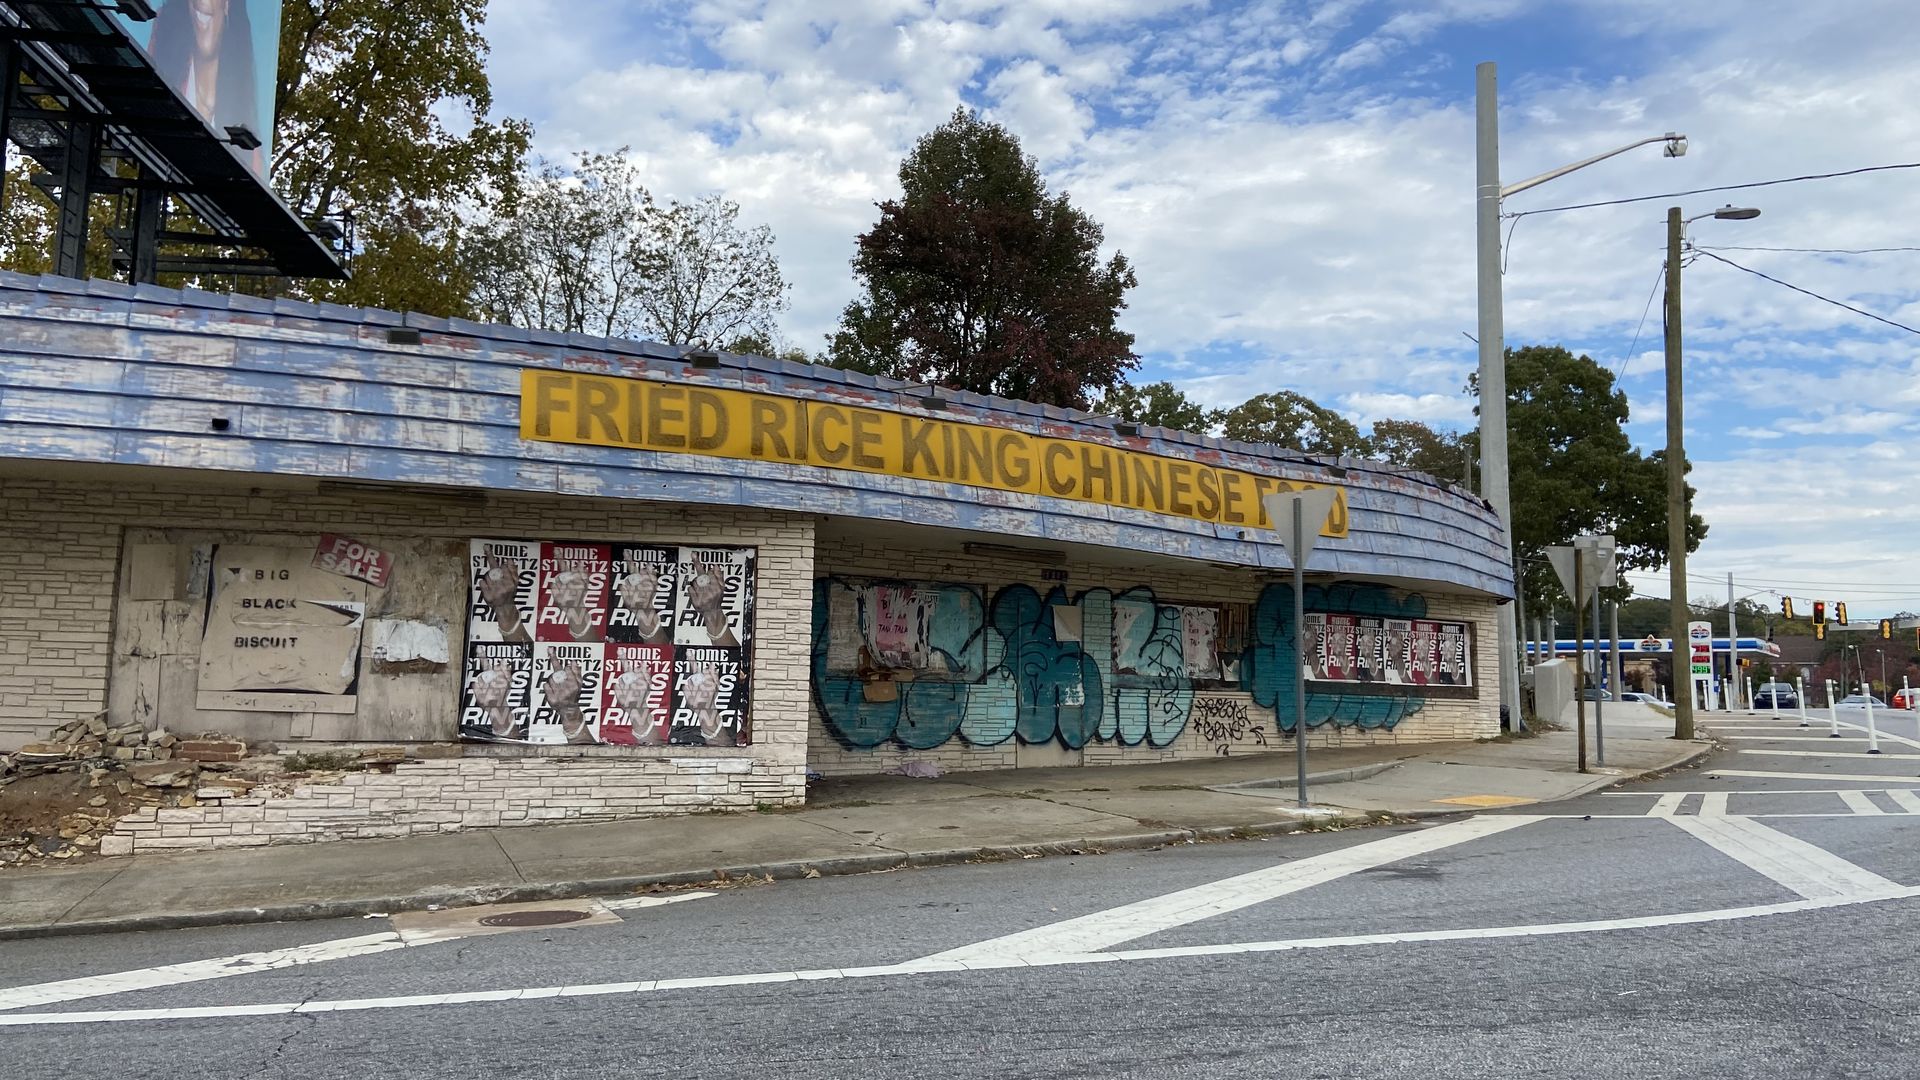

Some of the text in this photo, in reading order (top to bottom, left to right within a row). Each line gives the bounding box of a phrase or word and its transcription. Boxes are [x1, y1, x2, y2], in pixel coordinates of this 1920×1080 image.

[535, 374, 1346, 533] FRIED RICE KING CHINESE FD
[331, 539, 380, 566] FOR
[320, 553, 382, 583] SALE
[255, 569, 289, 580] BIG
[474, 568, 536, 588] KS
[681, 575, 742, 593] KS
[475, 587, 531, 606] TE
[684, 593, 737, 610] TE
[242, 598, 297, 609] BLACK
[1305, 615, 1321, 623] OME
[234, 637, 298, 648] BISCUIT
[1328, 633, 1354, 644] KS
[1356, 635, 1382, 646] KS
[1385, 638, 1409, 648] KS
[1412, 639, 1437, 650] KS
[1329, 644, 1352, 656] TE
[1358, 646, 1380, 657] TE
[1438, 640, 1463, 651] KS
[1386, 647, 1408, 659] TE
[1413, 649, 1435, 661] TE
[1440, 651, 1462, 662] TE
[1303, 655, 1325, 666] RIG
[1385, 659, 1410, 671] RIG
[536, 671, 600, 689] KS
[539, 689, 595, 707] TE
